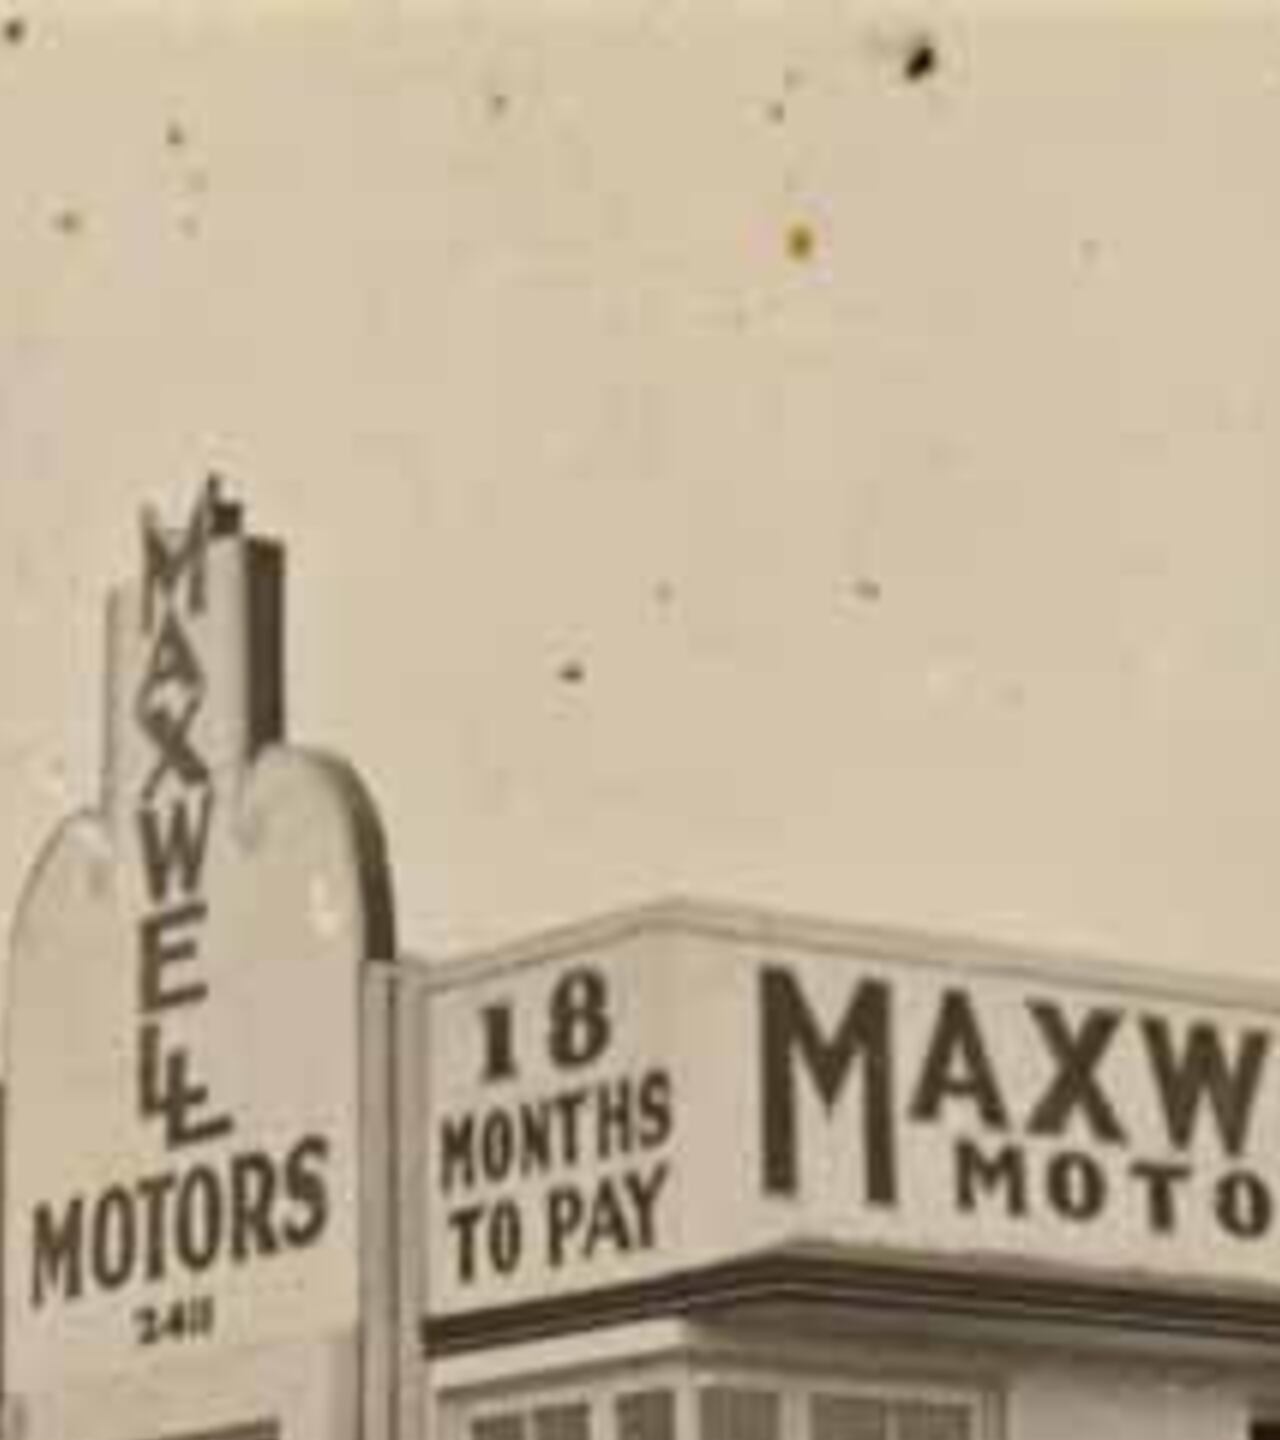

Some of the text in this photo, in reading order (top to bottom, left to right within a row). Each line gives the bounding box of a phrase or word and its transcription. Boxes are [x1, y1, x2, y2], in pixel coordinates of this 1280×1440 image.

[134, 470, 234, 1152] MAXWELL
[480, 962, 614, 1084] 18
[438, 1068, 676, 1196] MONTHS
[28, 1134, 330, 1308] MOTORS
[446, 1162, 668, 1286] TO PAY
[130, 1294, 216, 1345] 2411
